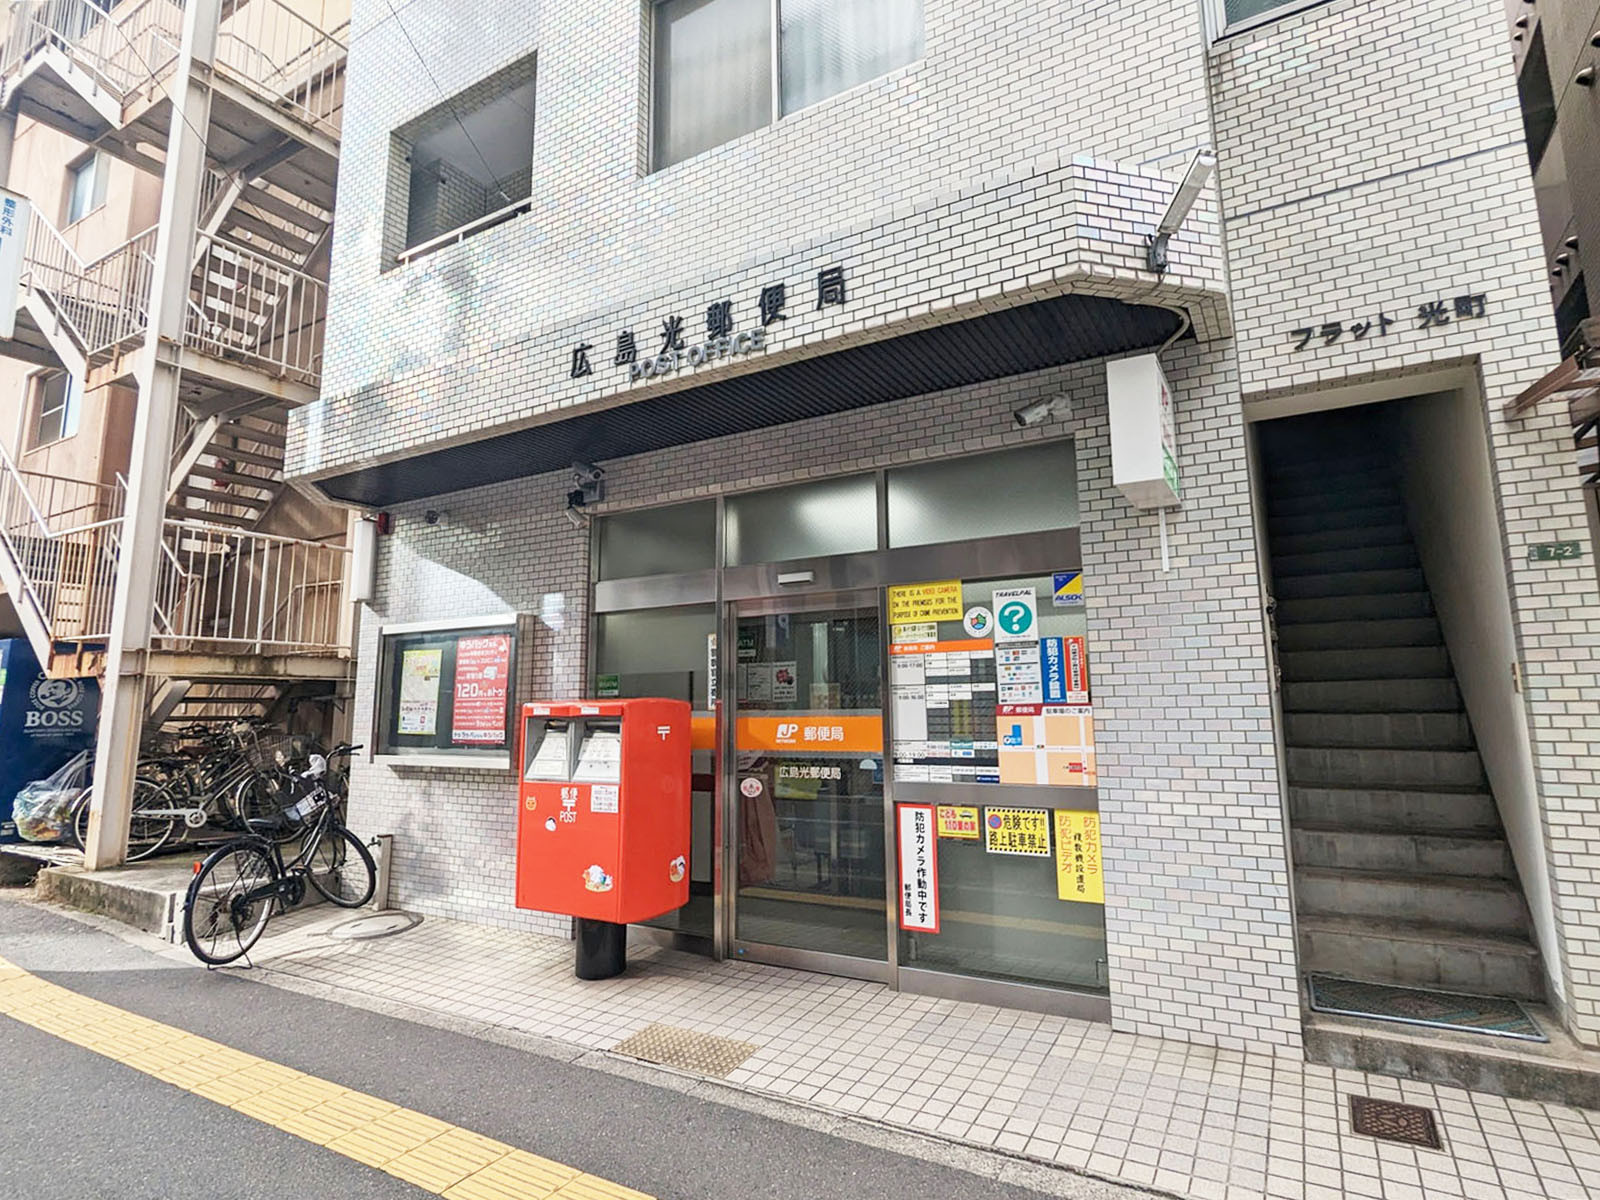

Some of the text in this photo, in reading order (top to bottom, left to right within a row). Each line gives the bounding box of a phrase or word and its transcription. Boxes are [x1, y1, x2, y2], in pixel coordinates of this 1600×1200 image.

[1, 197, 16, 236] 整形外科
[570, 266, 846, 378] 広島光郵便局
[1290, 293, 1486, 350] フラット 光町
[628, 328, 768, 382] POST OFFICE
[1547, 546, 1573, 558] 7-2
[24, 710, 84, 727] BOSS
[776, 724, 844, 741] JP 郵便局
[780, 766, 842, 780] 広島光郵便局
[560, 787, 578, 800] 郵便
[560, 811, 577, 823] POST
[940, 810, 957, 818] こども
[990, 831, 1047, 849] 路上駐車禁止
[1058, 815, 1072, 874] 防犯ビデオ
[1083, 816, 1098, 875] 防犯カメラ
[914, 811, 928, 923] 防犯カメラ作動中です
